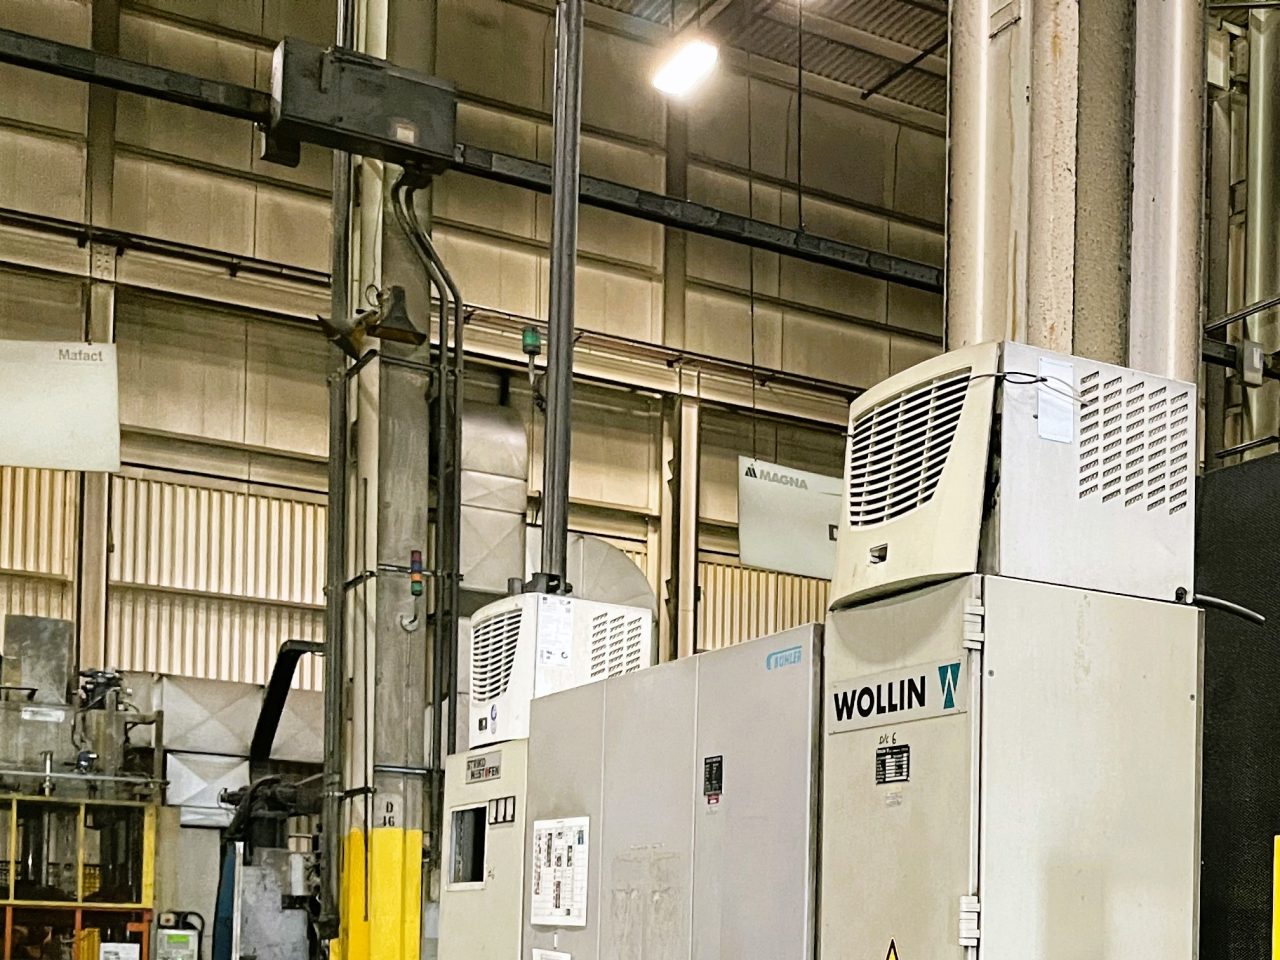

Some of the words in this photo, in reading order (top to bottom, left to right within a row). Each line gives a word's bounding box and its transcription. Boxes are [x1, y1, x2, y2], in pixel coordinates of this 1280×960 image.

[58, 349, 104, 362] Mafact
[759, 469, 809, 490] MAGNA
[833, 675, 926, 722] WOLLIN
[891, 732, 897, 745] 6
[386, 801, 394, 813] D
[383, 815, 395, 827] 16
